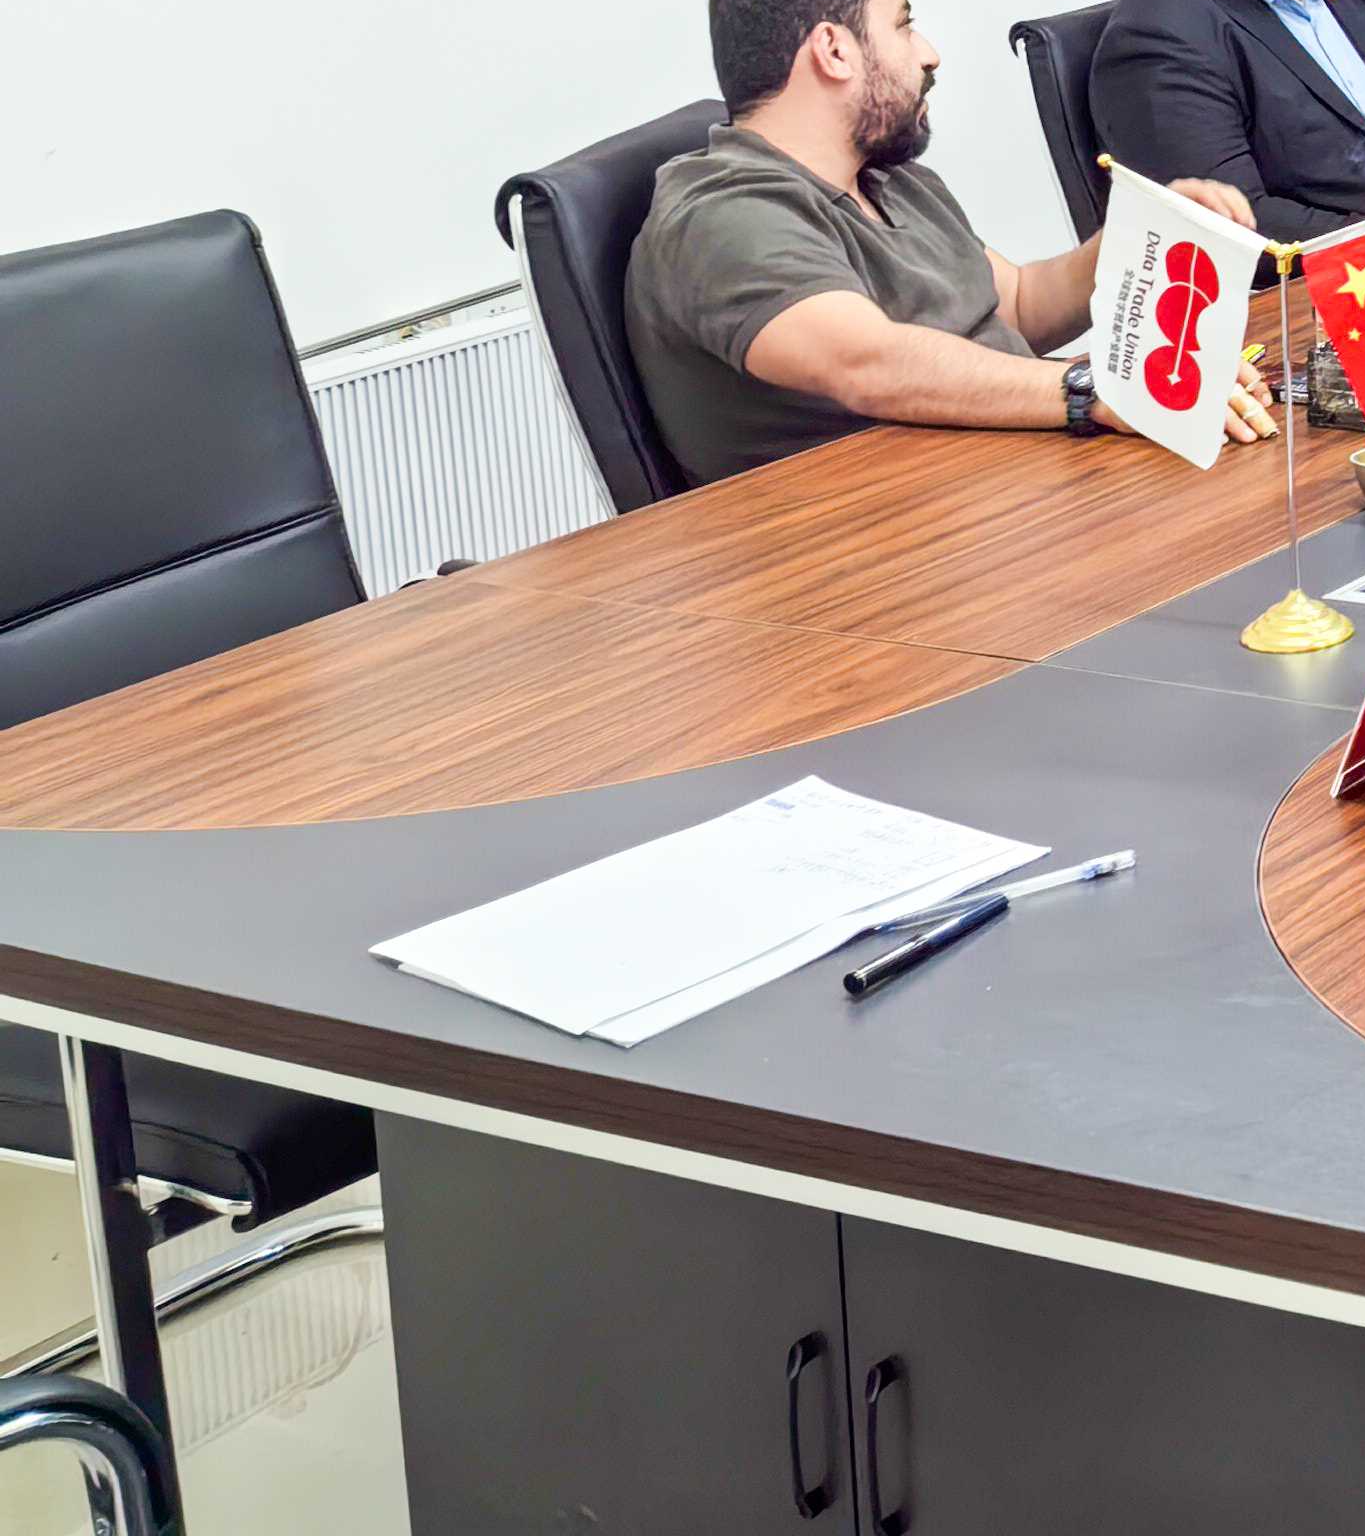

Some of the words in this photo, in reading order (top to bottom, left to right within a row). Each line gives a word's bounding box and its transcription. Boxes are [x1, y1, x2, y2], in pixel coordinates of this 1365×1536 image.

[1142, 230, 1161, 272] Data
[1127, 276, 1155, 329] Trade
[1120, 332, 1141, 381] Union
